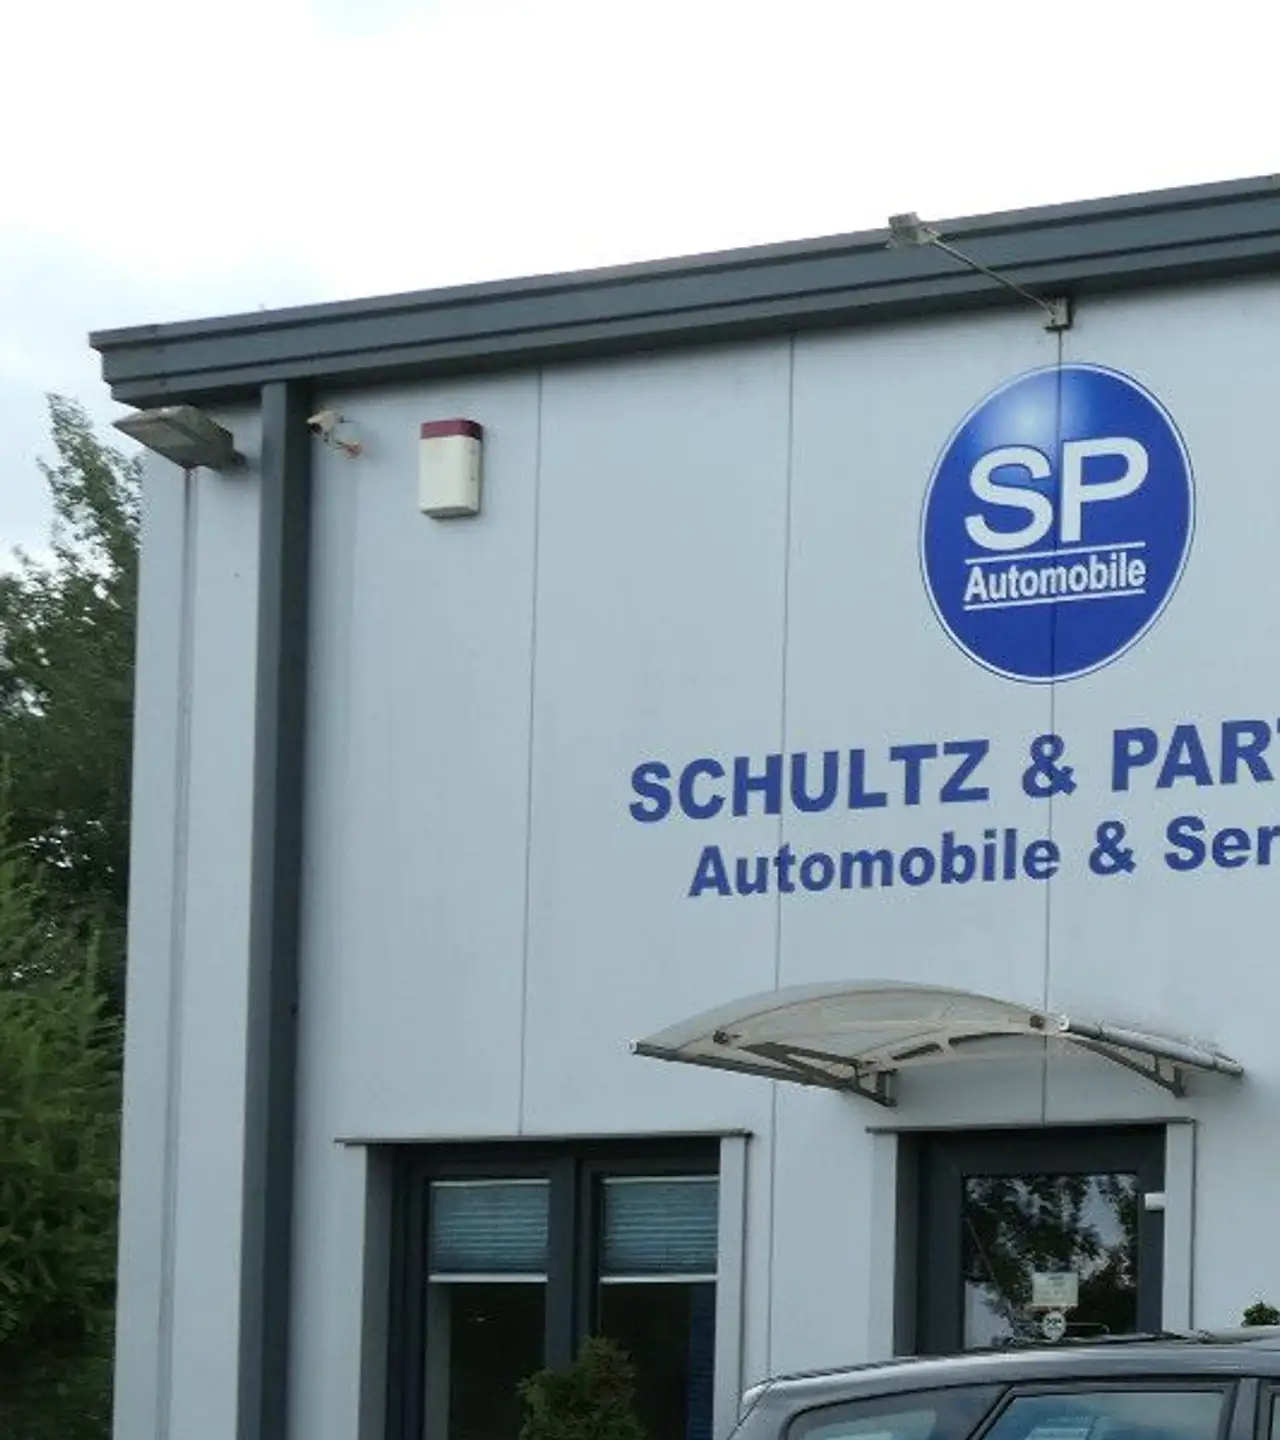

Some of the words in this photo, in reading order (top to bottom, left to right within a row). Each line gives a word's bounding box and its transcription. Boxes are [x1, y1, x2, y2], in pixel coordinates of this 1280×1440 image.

[964, 437, 1149, 552] SP
[964, 551, 1146, 603] Automobile
[629, 740, 990, 826] SCHULTZ
[1024, 731, 1076, 799] &
[690, 828, 1058, 897] Automobile
[1090, 822, 1135, 876] &
